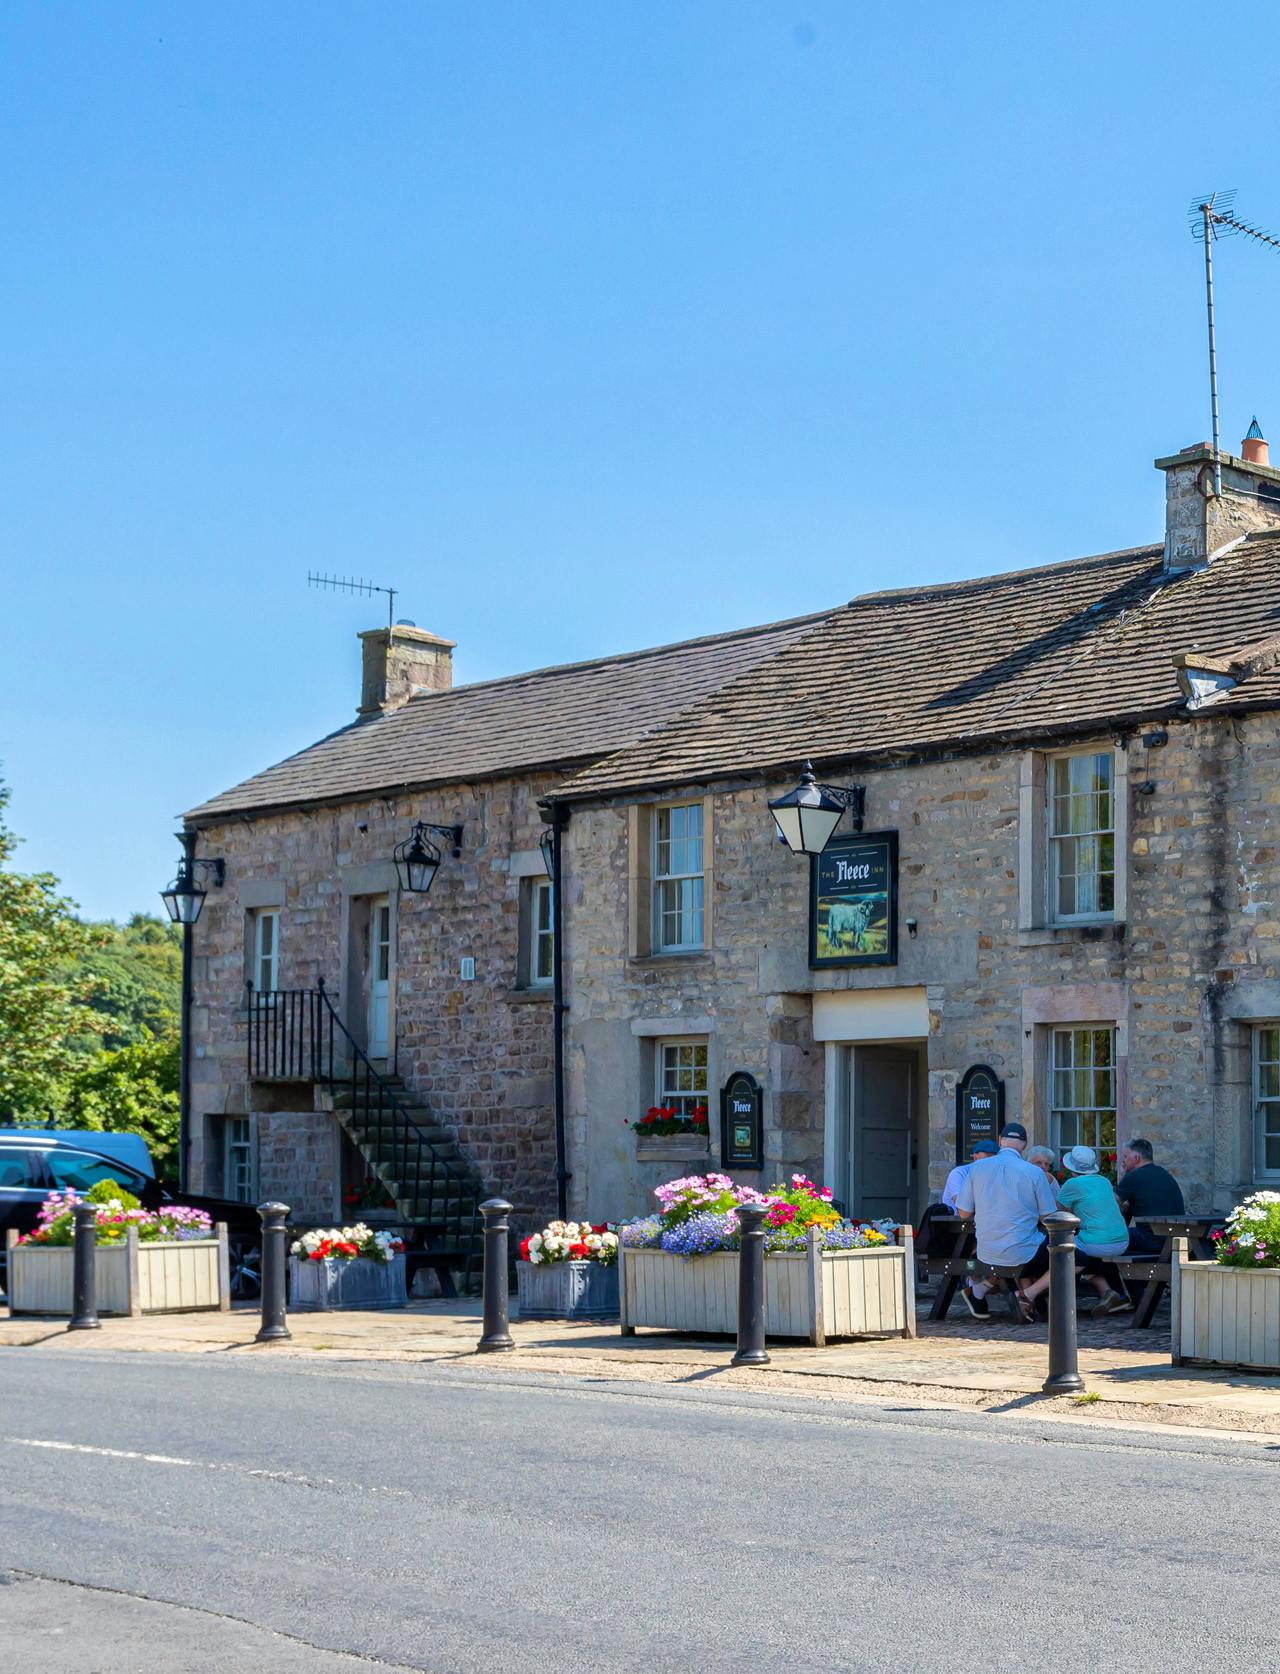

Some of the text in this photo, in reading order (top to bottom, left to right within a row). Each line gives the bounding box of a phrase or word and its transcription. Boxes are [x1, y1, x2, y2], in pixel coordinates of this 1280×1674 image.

[836, 860, 870, 883] Fleece
[733, 1100, 751, 1113] Fleece
[970, 1096, 991, 1110] Fleece
